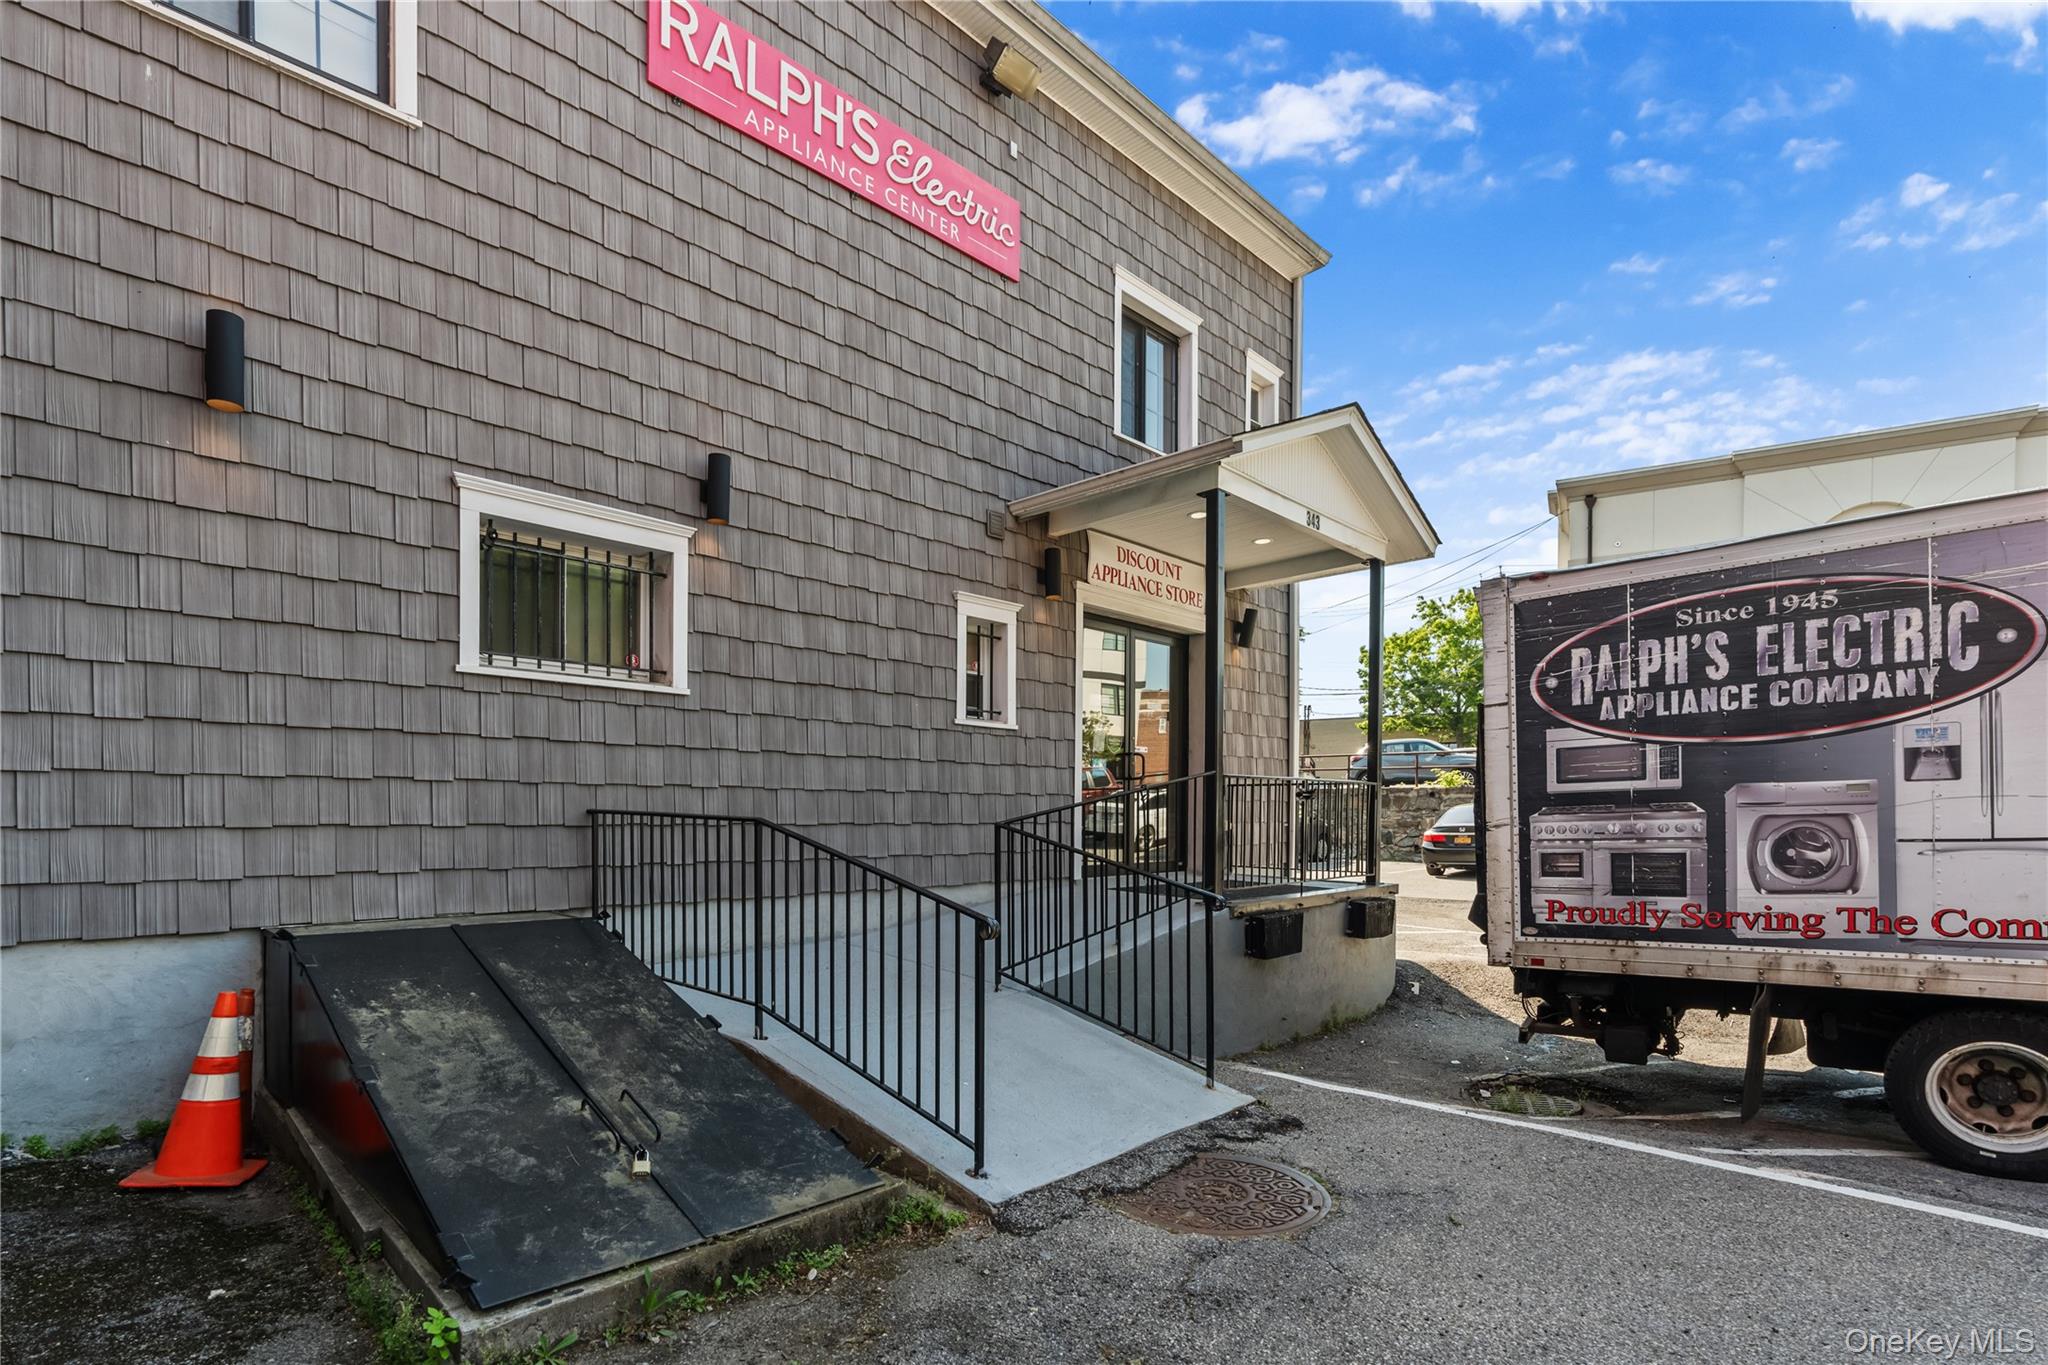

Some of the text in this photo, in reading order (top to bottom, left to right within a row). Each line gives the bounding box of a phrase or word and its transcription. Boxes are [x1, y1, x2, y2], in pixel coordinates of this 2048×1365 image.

[660, 0, 1015, 247] RALPH'S Electric
[744, 108, 960, 242] APPLIANCE CENTER
[1306, 510, 1320, 531] 343
[1091, 563, 1203, 609] APPLIANCE STORE
[1116, 546, 1183, 581] DISCOUNT
[1675, 589, 1839, 629] Since 1945
[1570, 600, 1979, 706] RALPH'S ELECTRIC
[1599, 666, 1940, 722] APPLIANCE COMPANY
[1544, 898, 2048, 941] Proudly Serving The Com
